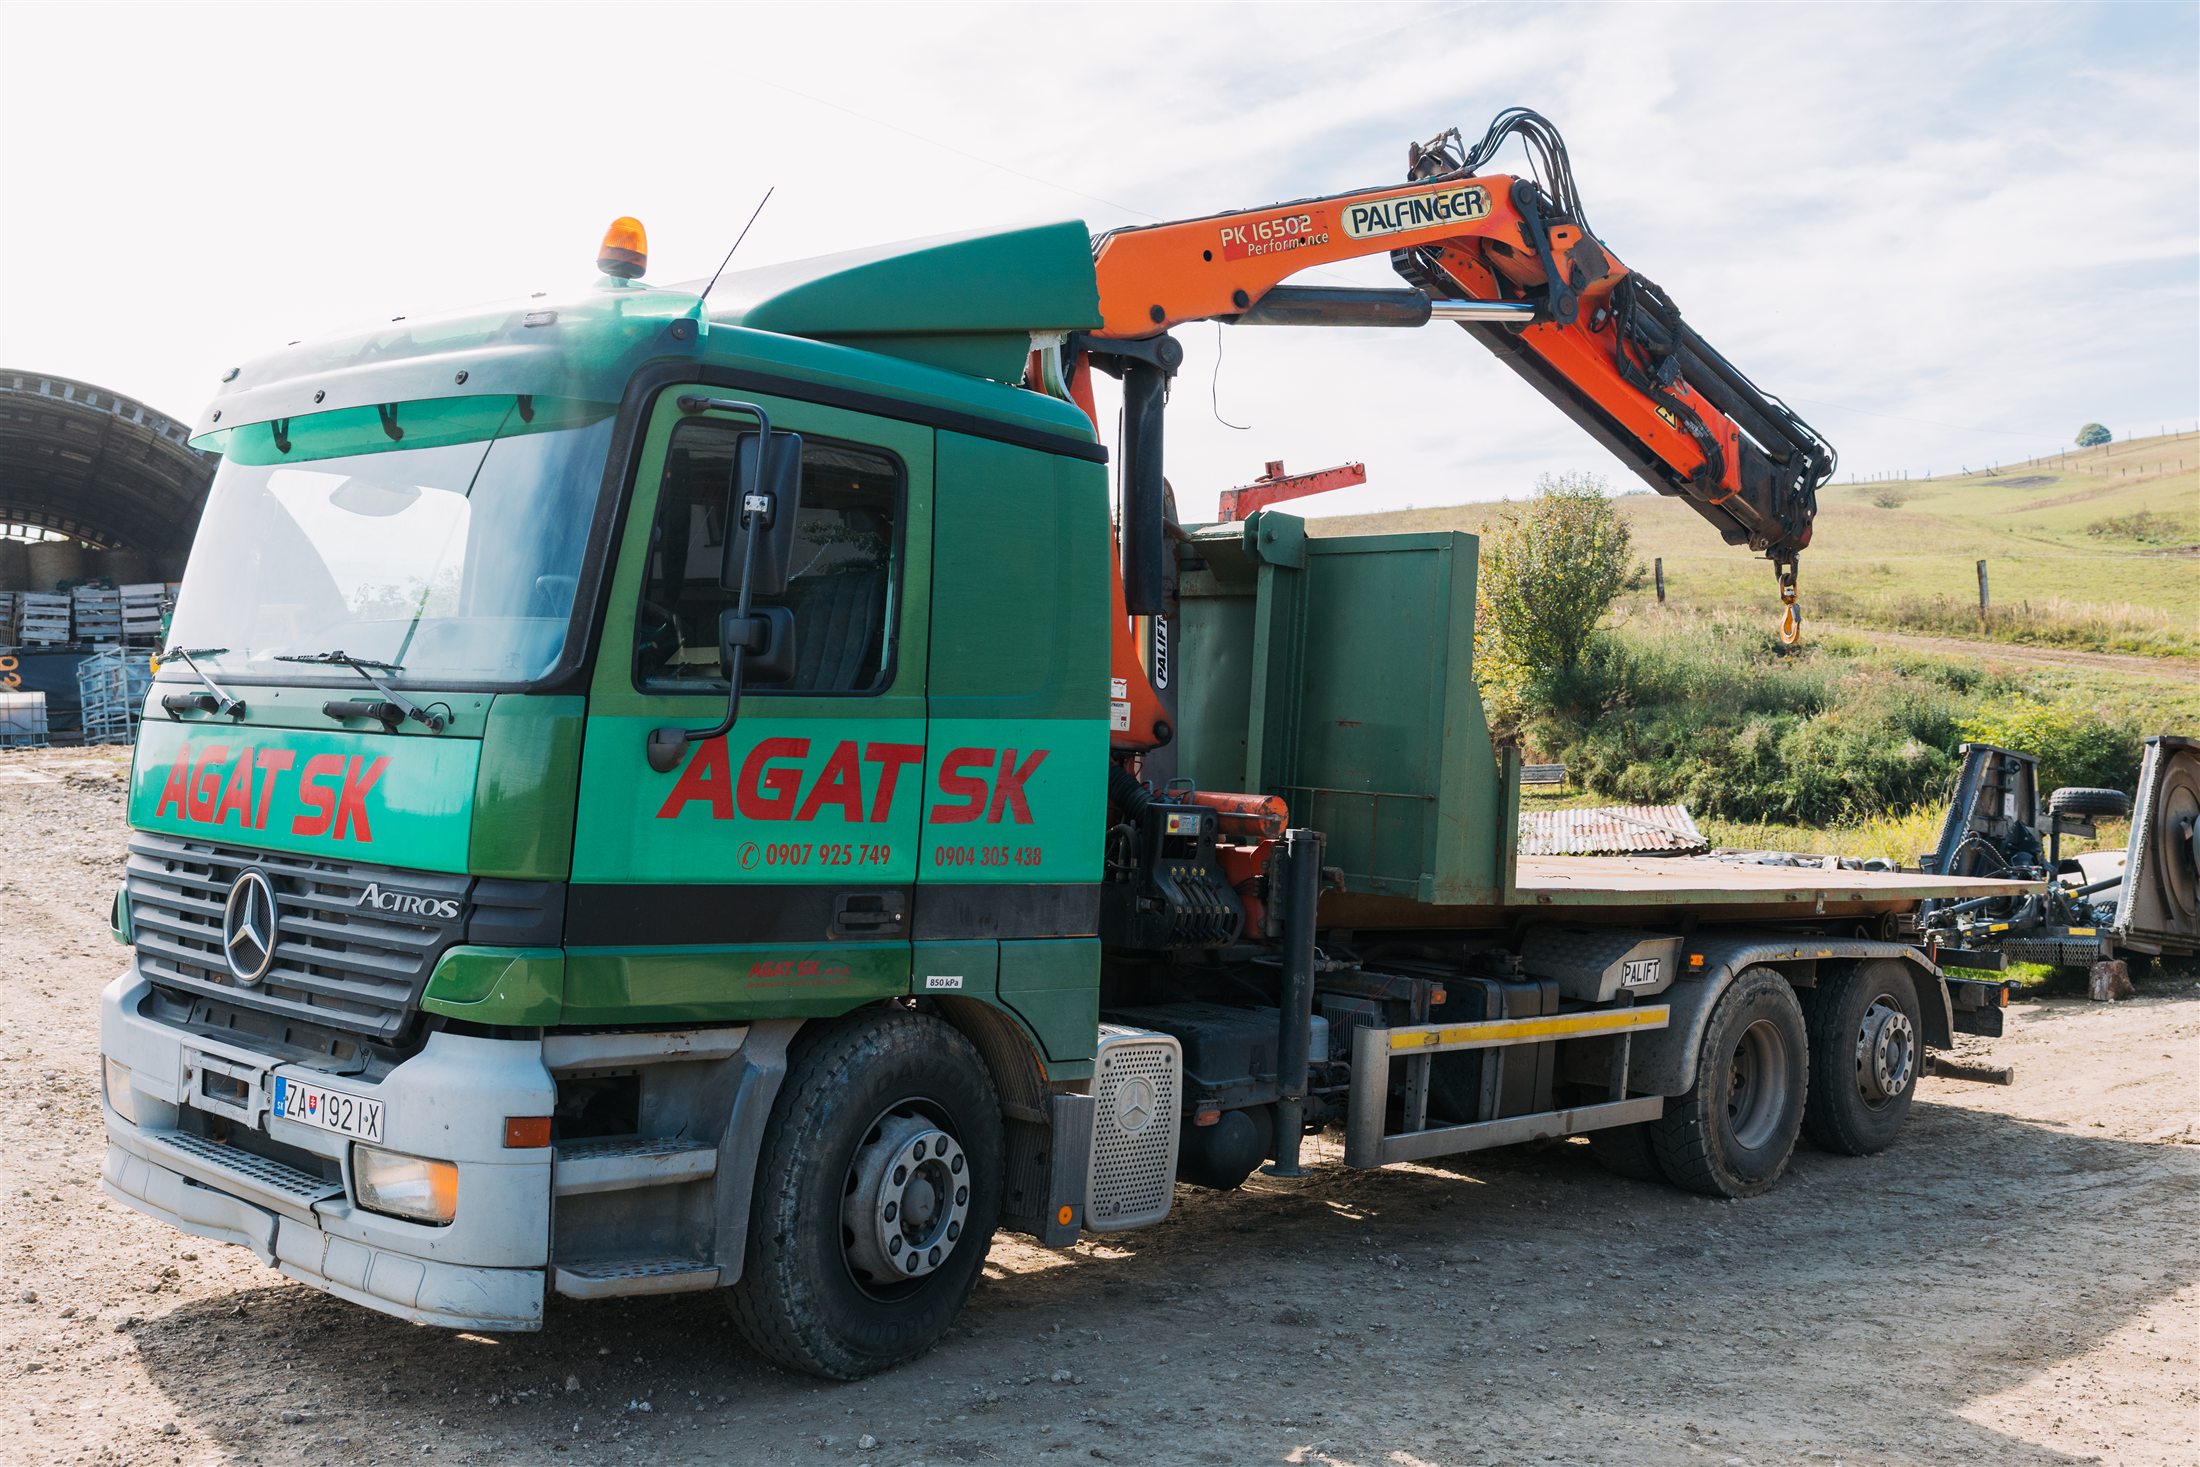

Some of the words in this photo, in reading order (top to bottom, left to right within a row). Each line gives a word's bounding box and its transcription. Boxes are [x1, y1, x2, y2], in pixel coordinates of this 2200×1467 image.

[1351, 190, 1484, 234] PALFINGER
[1220, 226, 1247, 247] PK
[1252, 214, 1313, 242] 16502
[1157, 616, 1167, 683] PALIFT
[656, 733, 926, 824] AGAT
[929, 746, 1051, 825] SK
[155, 743, 297, 831] AGAT
[291, 754, 394, 843] SK
[766, 844, 813, 866] 0907
[818, 844, 852, 866] 925
[858, 844, 891, 866] 749
[935, 846, 976, 867] 0904
[980, 846, 1009, 867] 305
[1013, 846, 1042, 867] 438
[747, 961, 796, 978] AGAT
[929, 978, 945, 987] 850
[945, 978, 959, 987] kPa
[1625, 962, 1659, 983] PALIFT
[276, 1101, 284, 1111] SK
[286, 1084, 307, 1120] ZA
